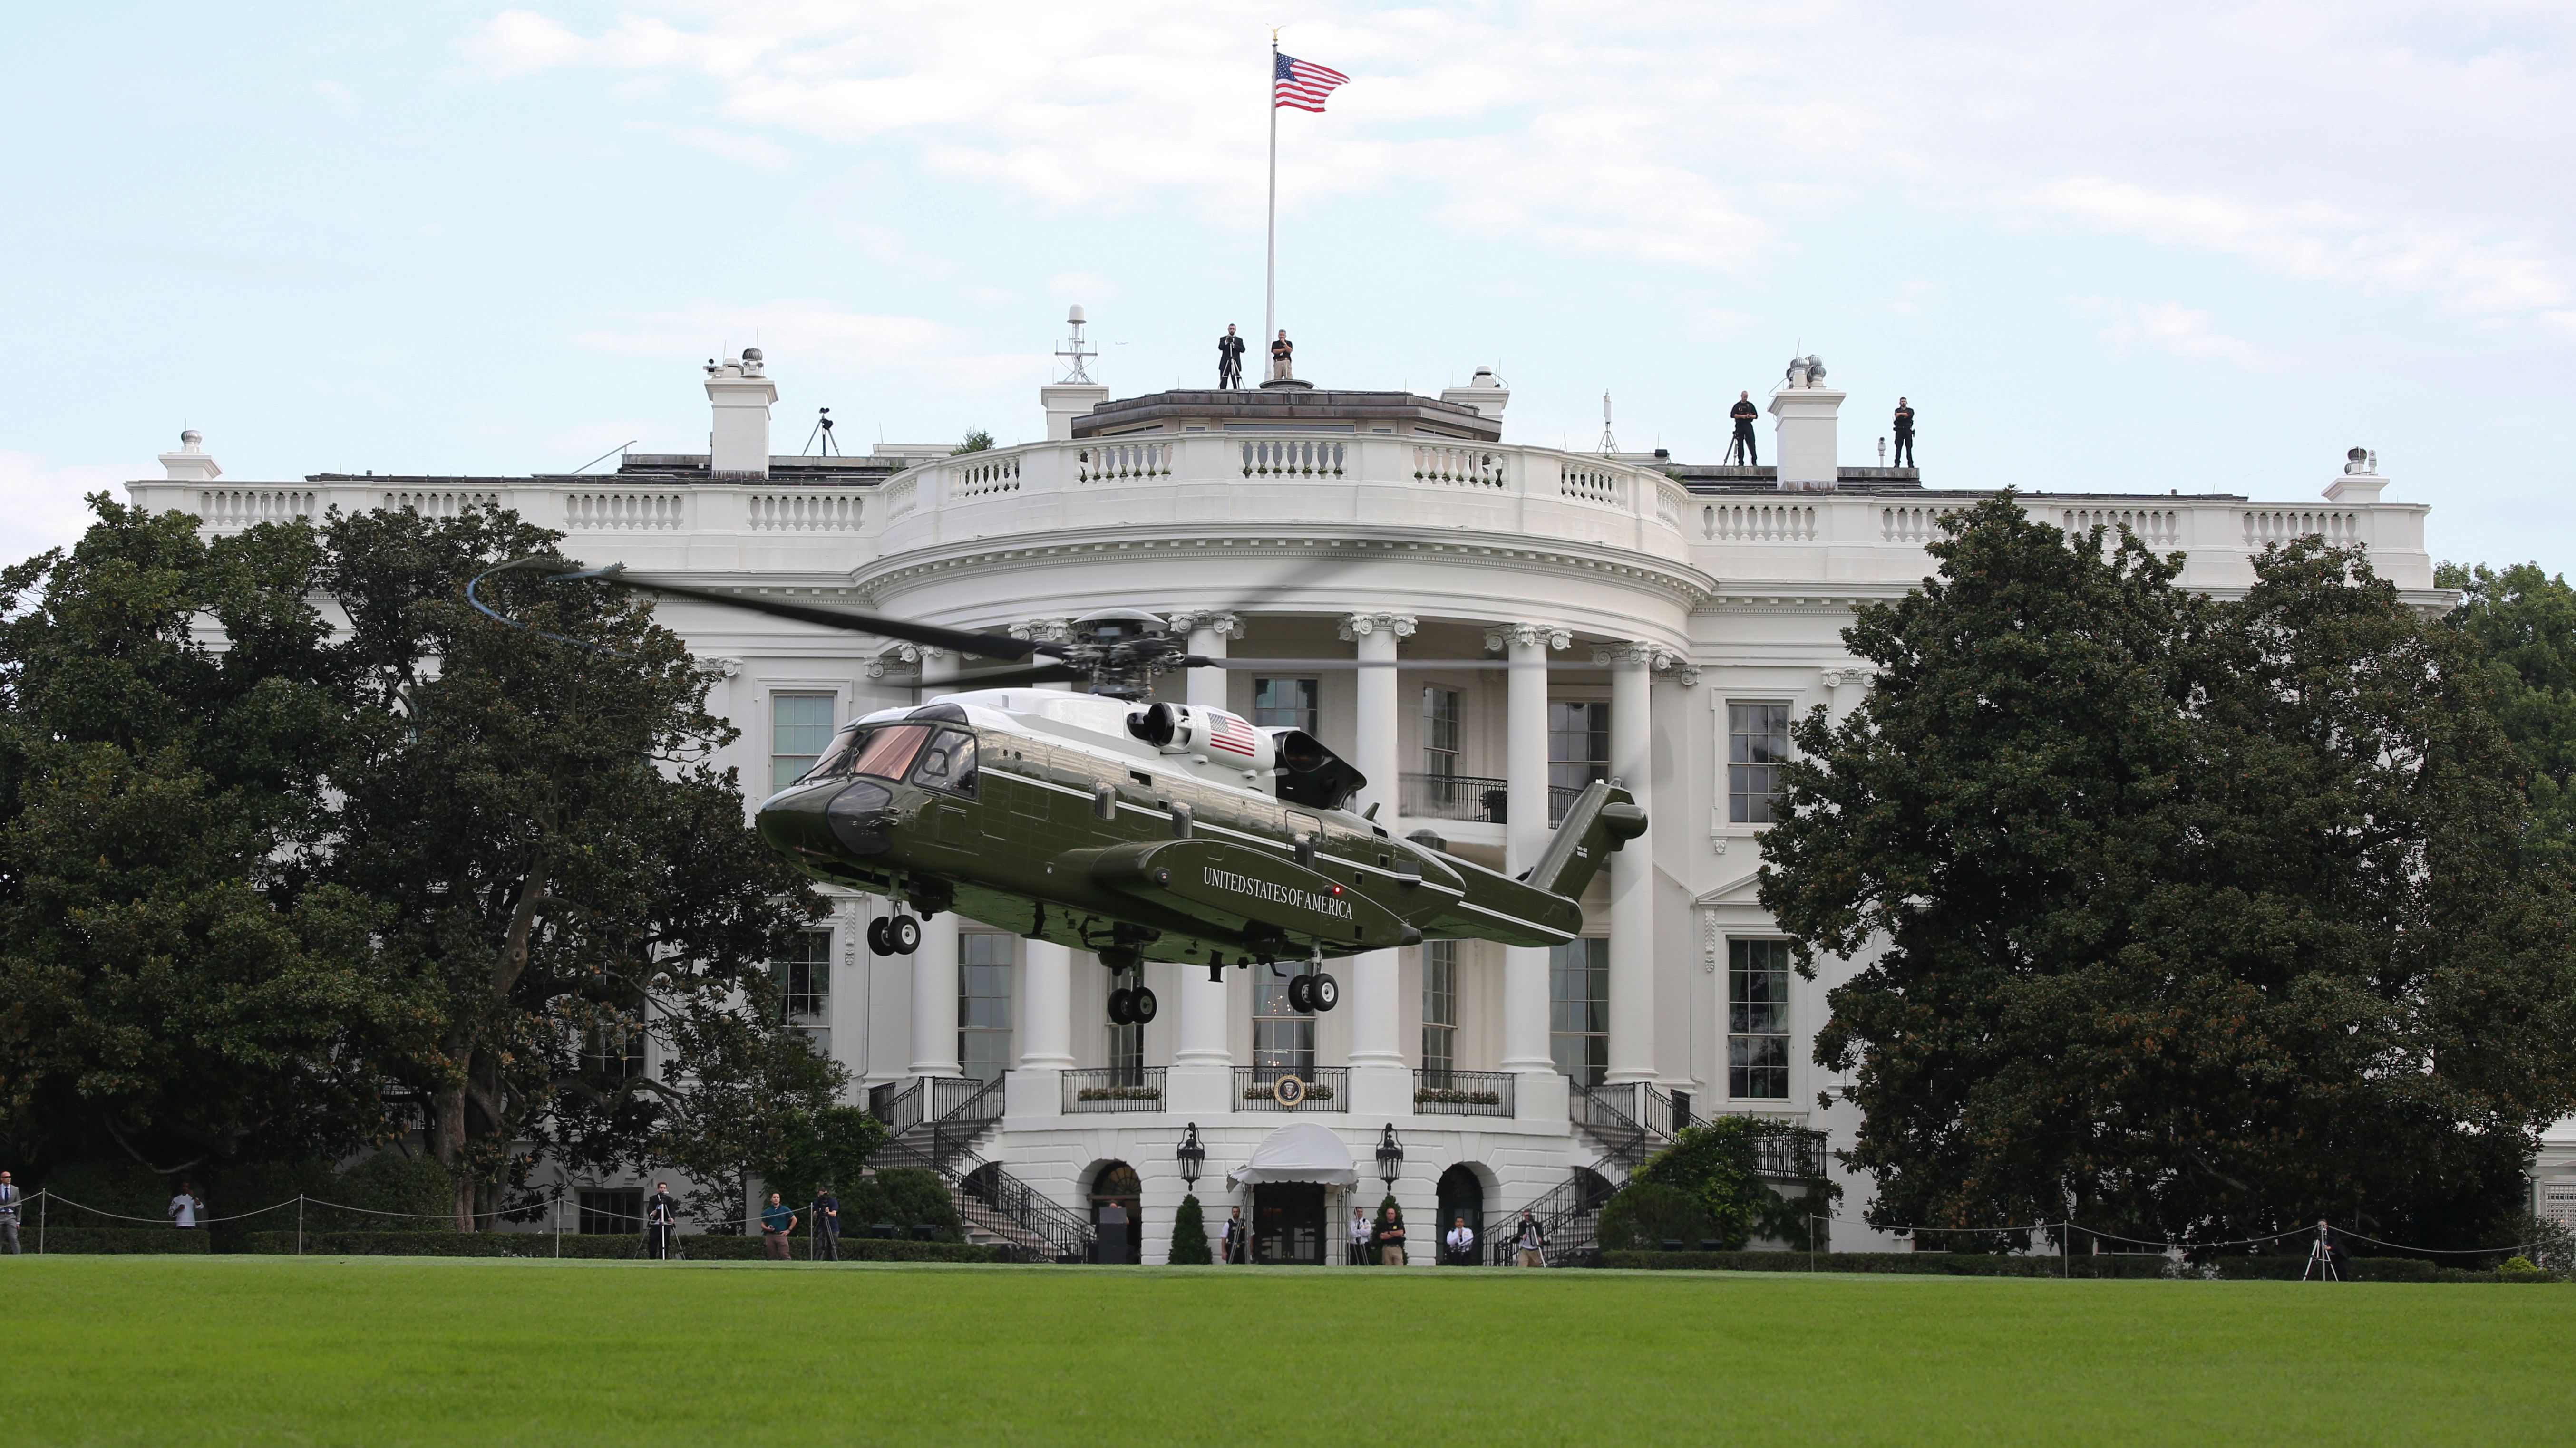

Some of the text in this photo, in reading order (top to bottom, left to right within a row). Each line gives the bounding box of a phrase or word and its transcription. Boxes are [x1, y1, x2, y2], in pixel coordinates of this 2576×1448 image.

[1204, 867, 1353, 920] UNITED STATES OF AMERICA
